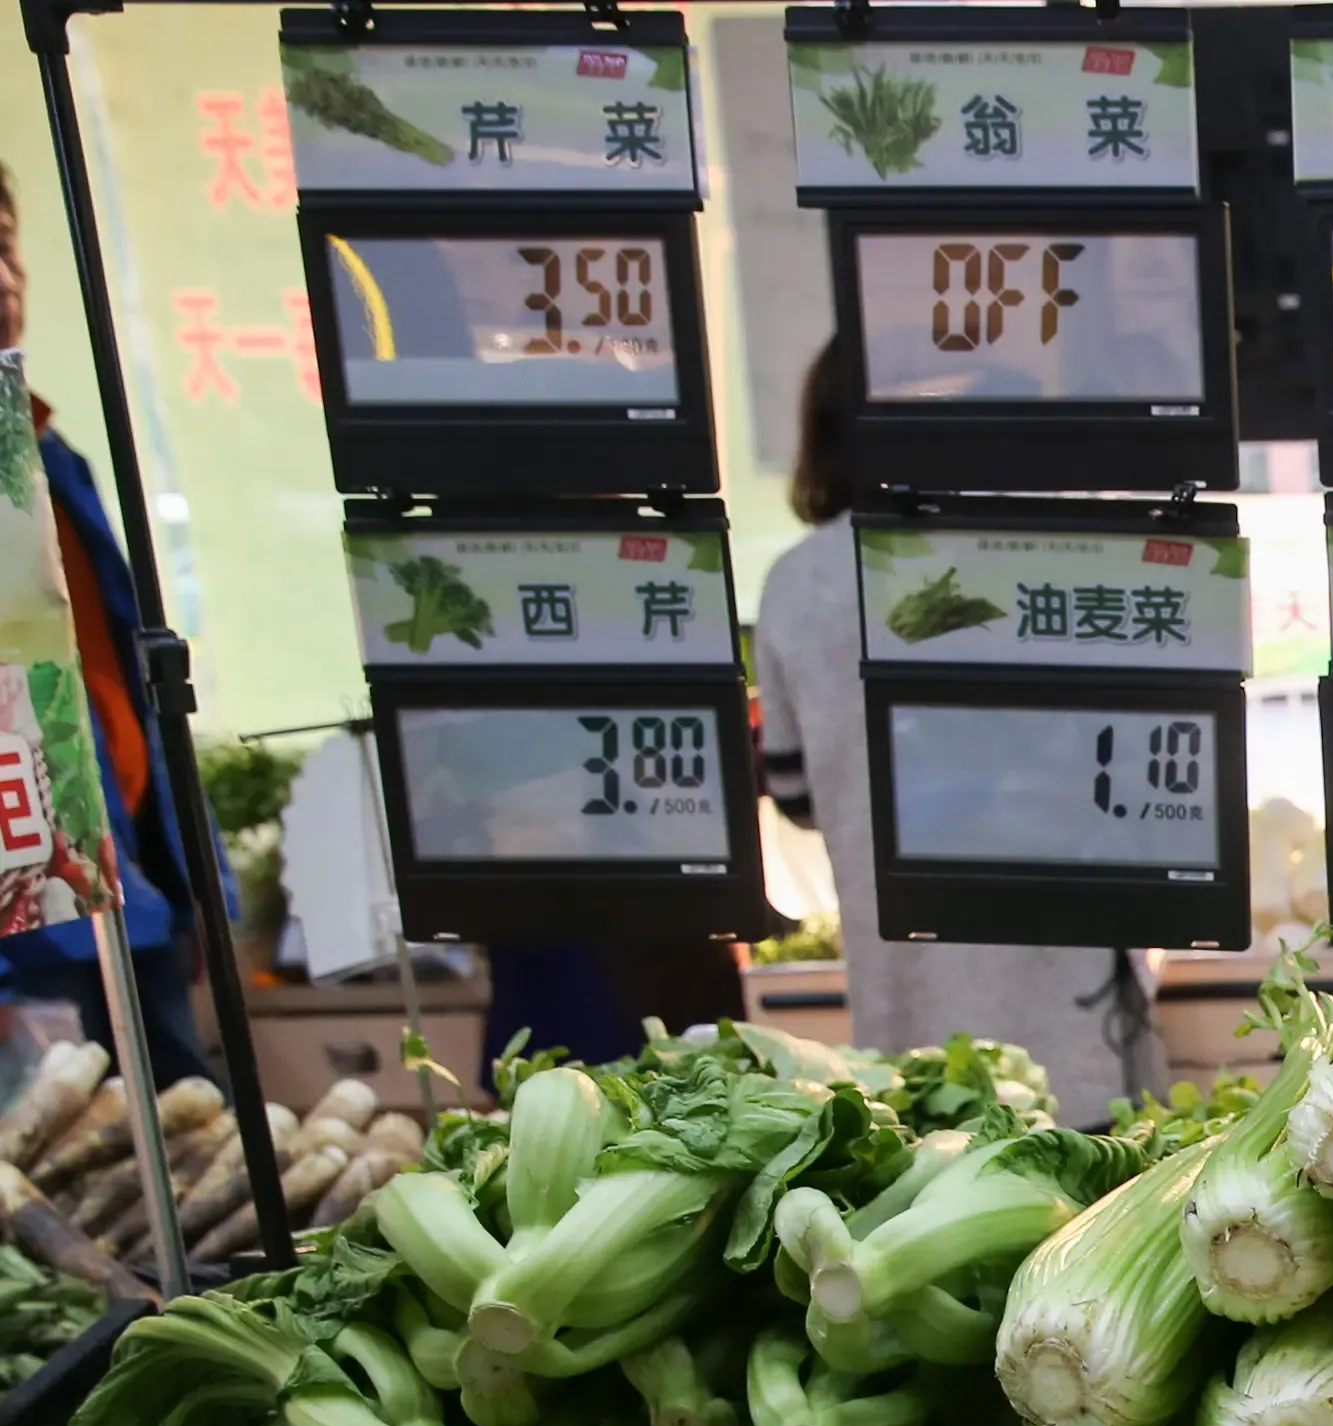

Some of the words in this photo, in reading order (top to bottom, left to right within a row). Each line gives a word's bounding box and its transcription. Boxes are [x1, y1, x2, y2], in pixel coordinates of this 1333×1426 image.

[461, 101, 662, 162] 芹菜
[962, 95, 1147, 157] 翁菜
[517, 248, 652, 355] 3.50
[932, 243, 1084, 351] OFF
[518, 582, 693, 638] 西芹
[1016, 582, 1187, 642] 油麦菜
[577, 716, 704, 815] 3.80
[1093, 721, 1201, 819] 1.10
